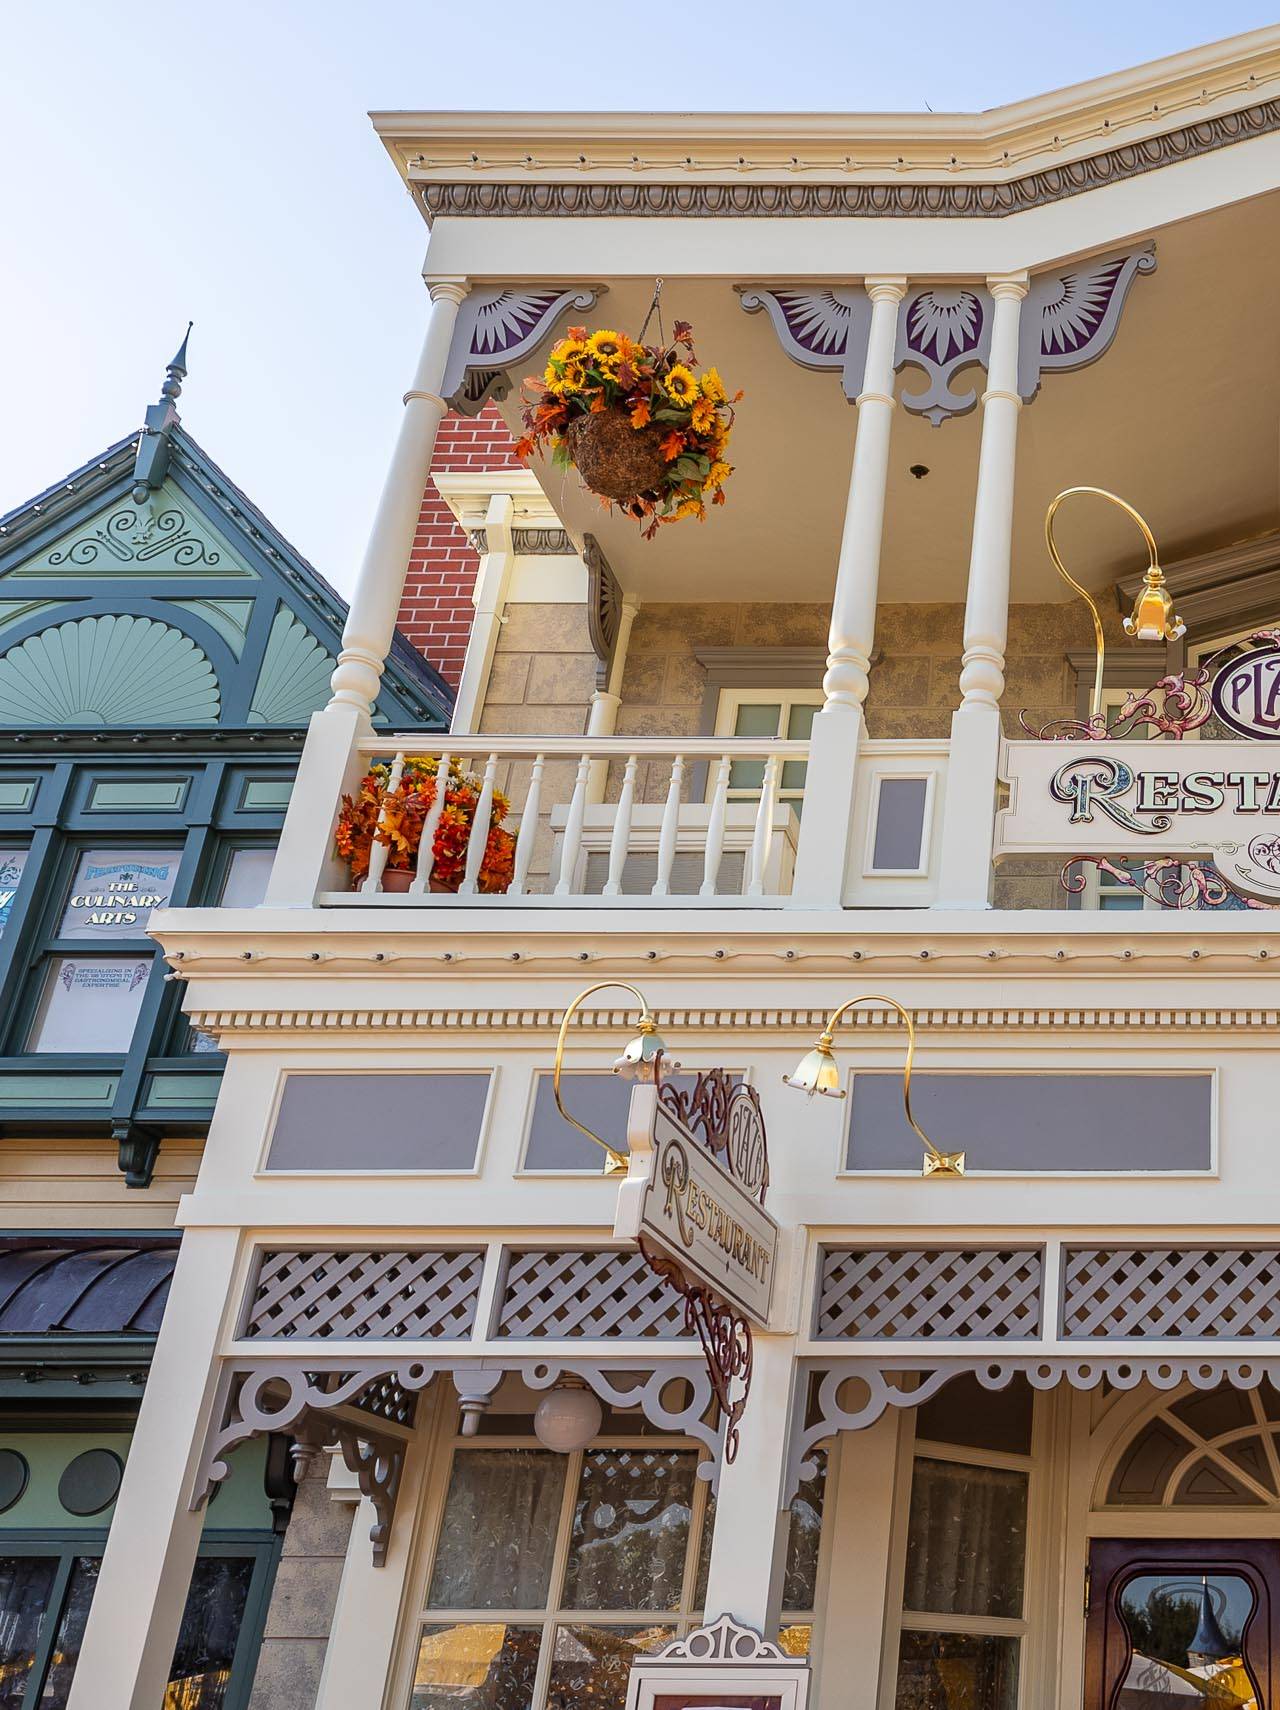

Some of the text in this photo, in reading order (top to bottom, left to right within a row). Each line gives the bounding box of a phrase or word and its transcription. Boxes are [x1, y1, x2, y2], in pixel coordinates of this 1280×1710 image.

[108, 882, 138, 892] THE
[70, 895, 167, 909] CULINARY
[85, 912, 137, 925] ARTS
[732, 1104, 764, 1188] PLAZA
[662, 1140, 770, 1285] RESTAURANT
